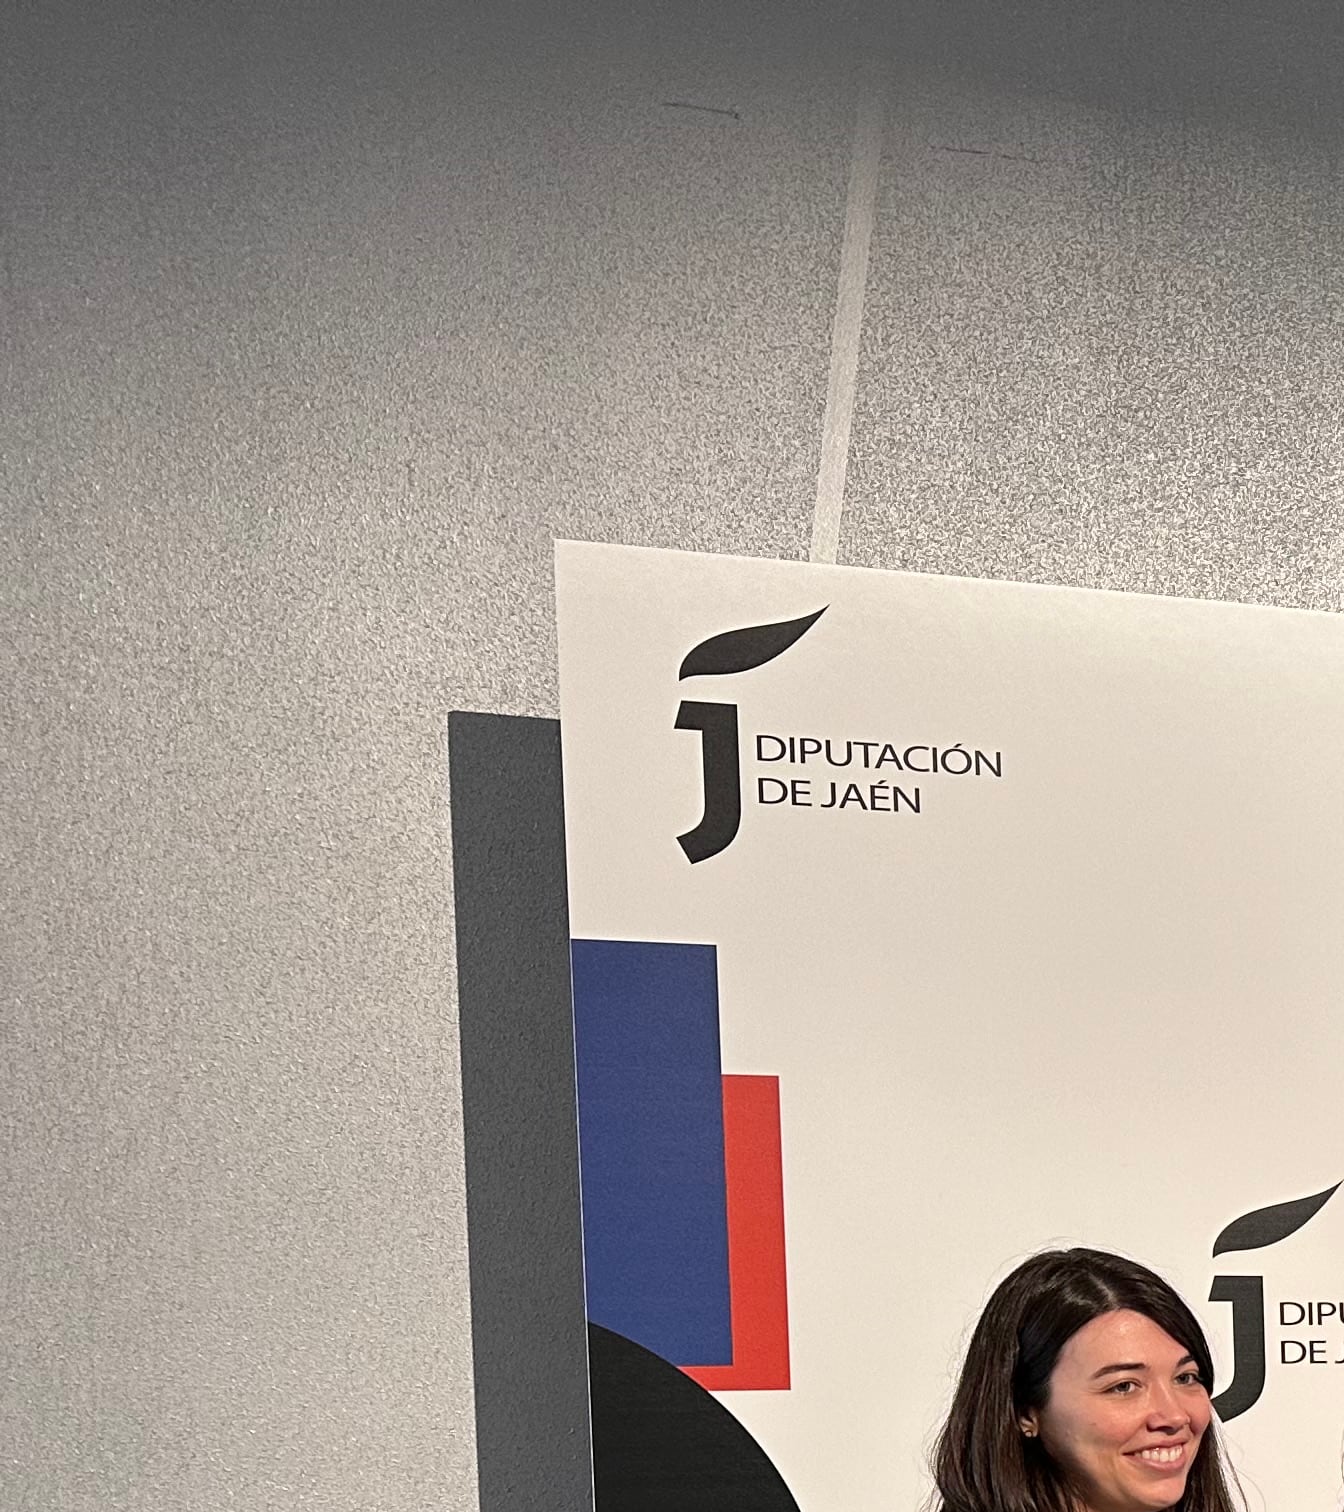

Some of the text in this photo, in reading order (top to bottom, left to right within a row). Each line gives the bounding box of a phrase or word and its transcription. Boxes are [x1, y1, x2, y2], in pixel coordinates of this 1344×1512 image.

[756, 735, 1002, 777] DIPUTACIÓN
[757, 777, 921, 814] DE JAÉN
[1280, 1340, 1328, 1365] DE
